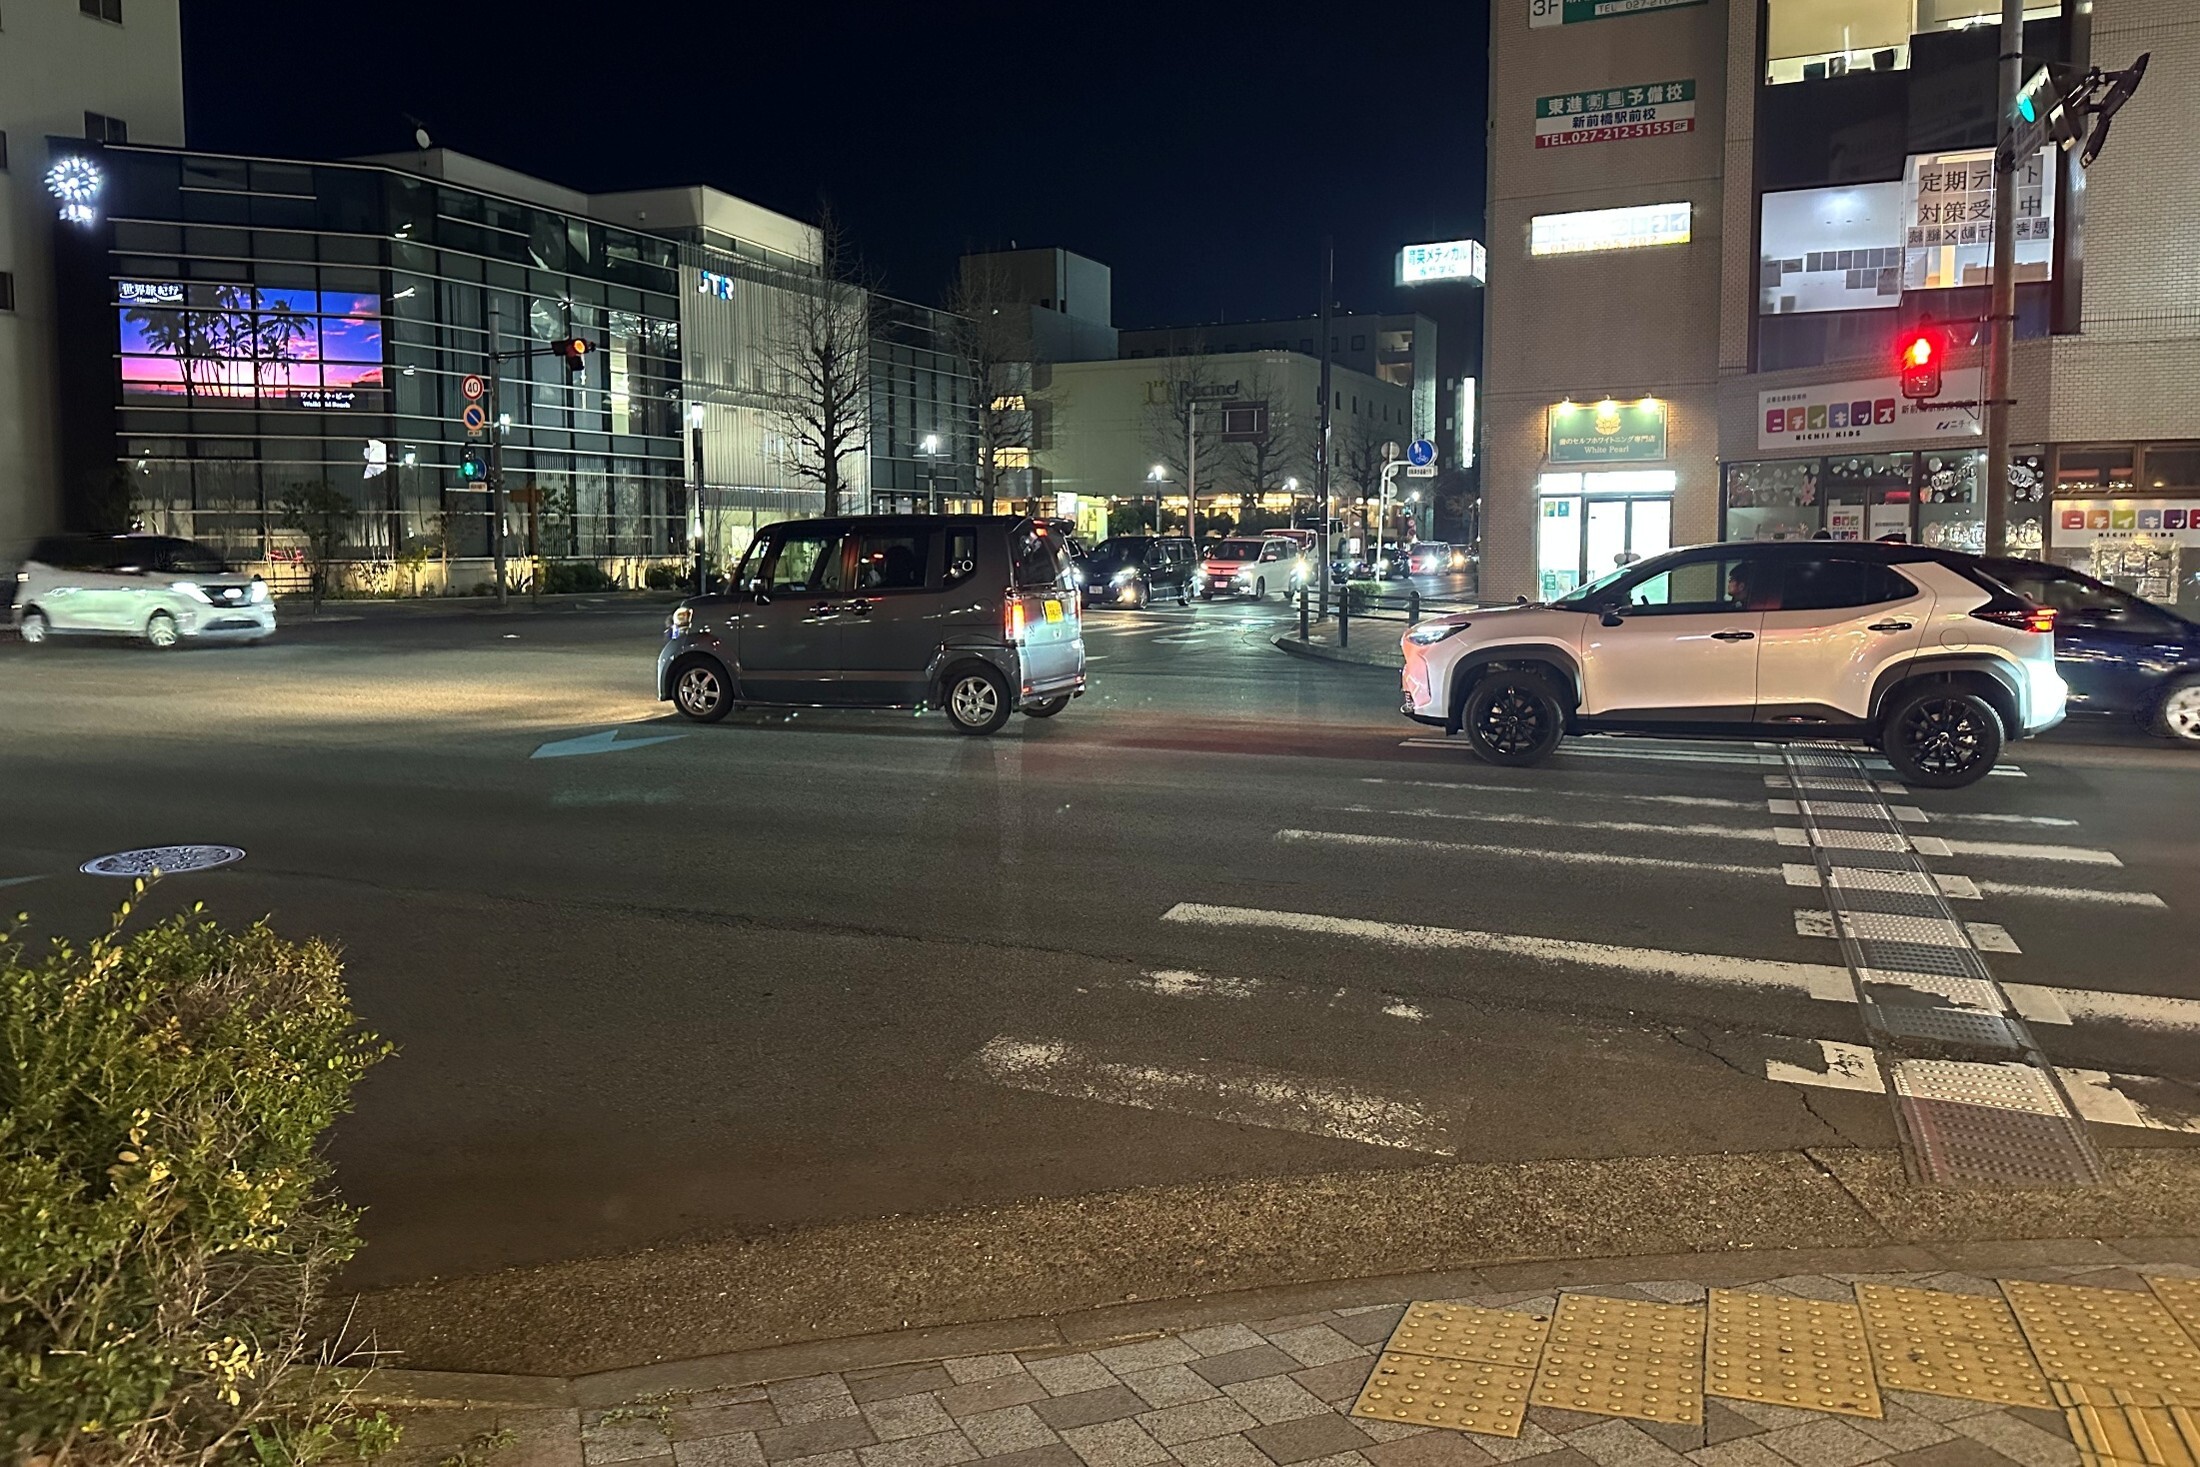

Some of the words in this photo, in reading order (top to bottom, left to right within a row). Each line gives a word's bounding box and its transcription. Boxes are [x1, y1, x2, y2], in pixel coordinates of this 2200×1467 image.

[1548, 83, 1683, 115] 東進衛星予備校
[1572, 108, 1656, 128] 新前橋駅前校
[1920, 165, 2038, 193] 定期テト
[1919, 196, 2040, 223] 対策受中
[698, 271, 734, 300] JTR
[467, 382, 479, 393] 40
[1769, 404, 1895, 432] ニチイキッズ
[1795, 432, 1830, 441] NICHII
[1835, 430, 1861, 438] KIDS
[1584, 446, 1607, 454] White
[1609, 445, 1629, 453] Pearl
